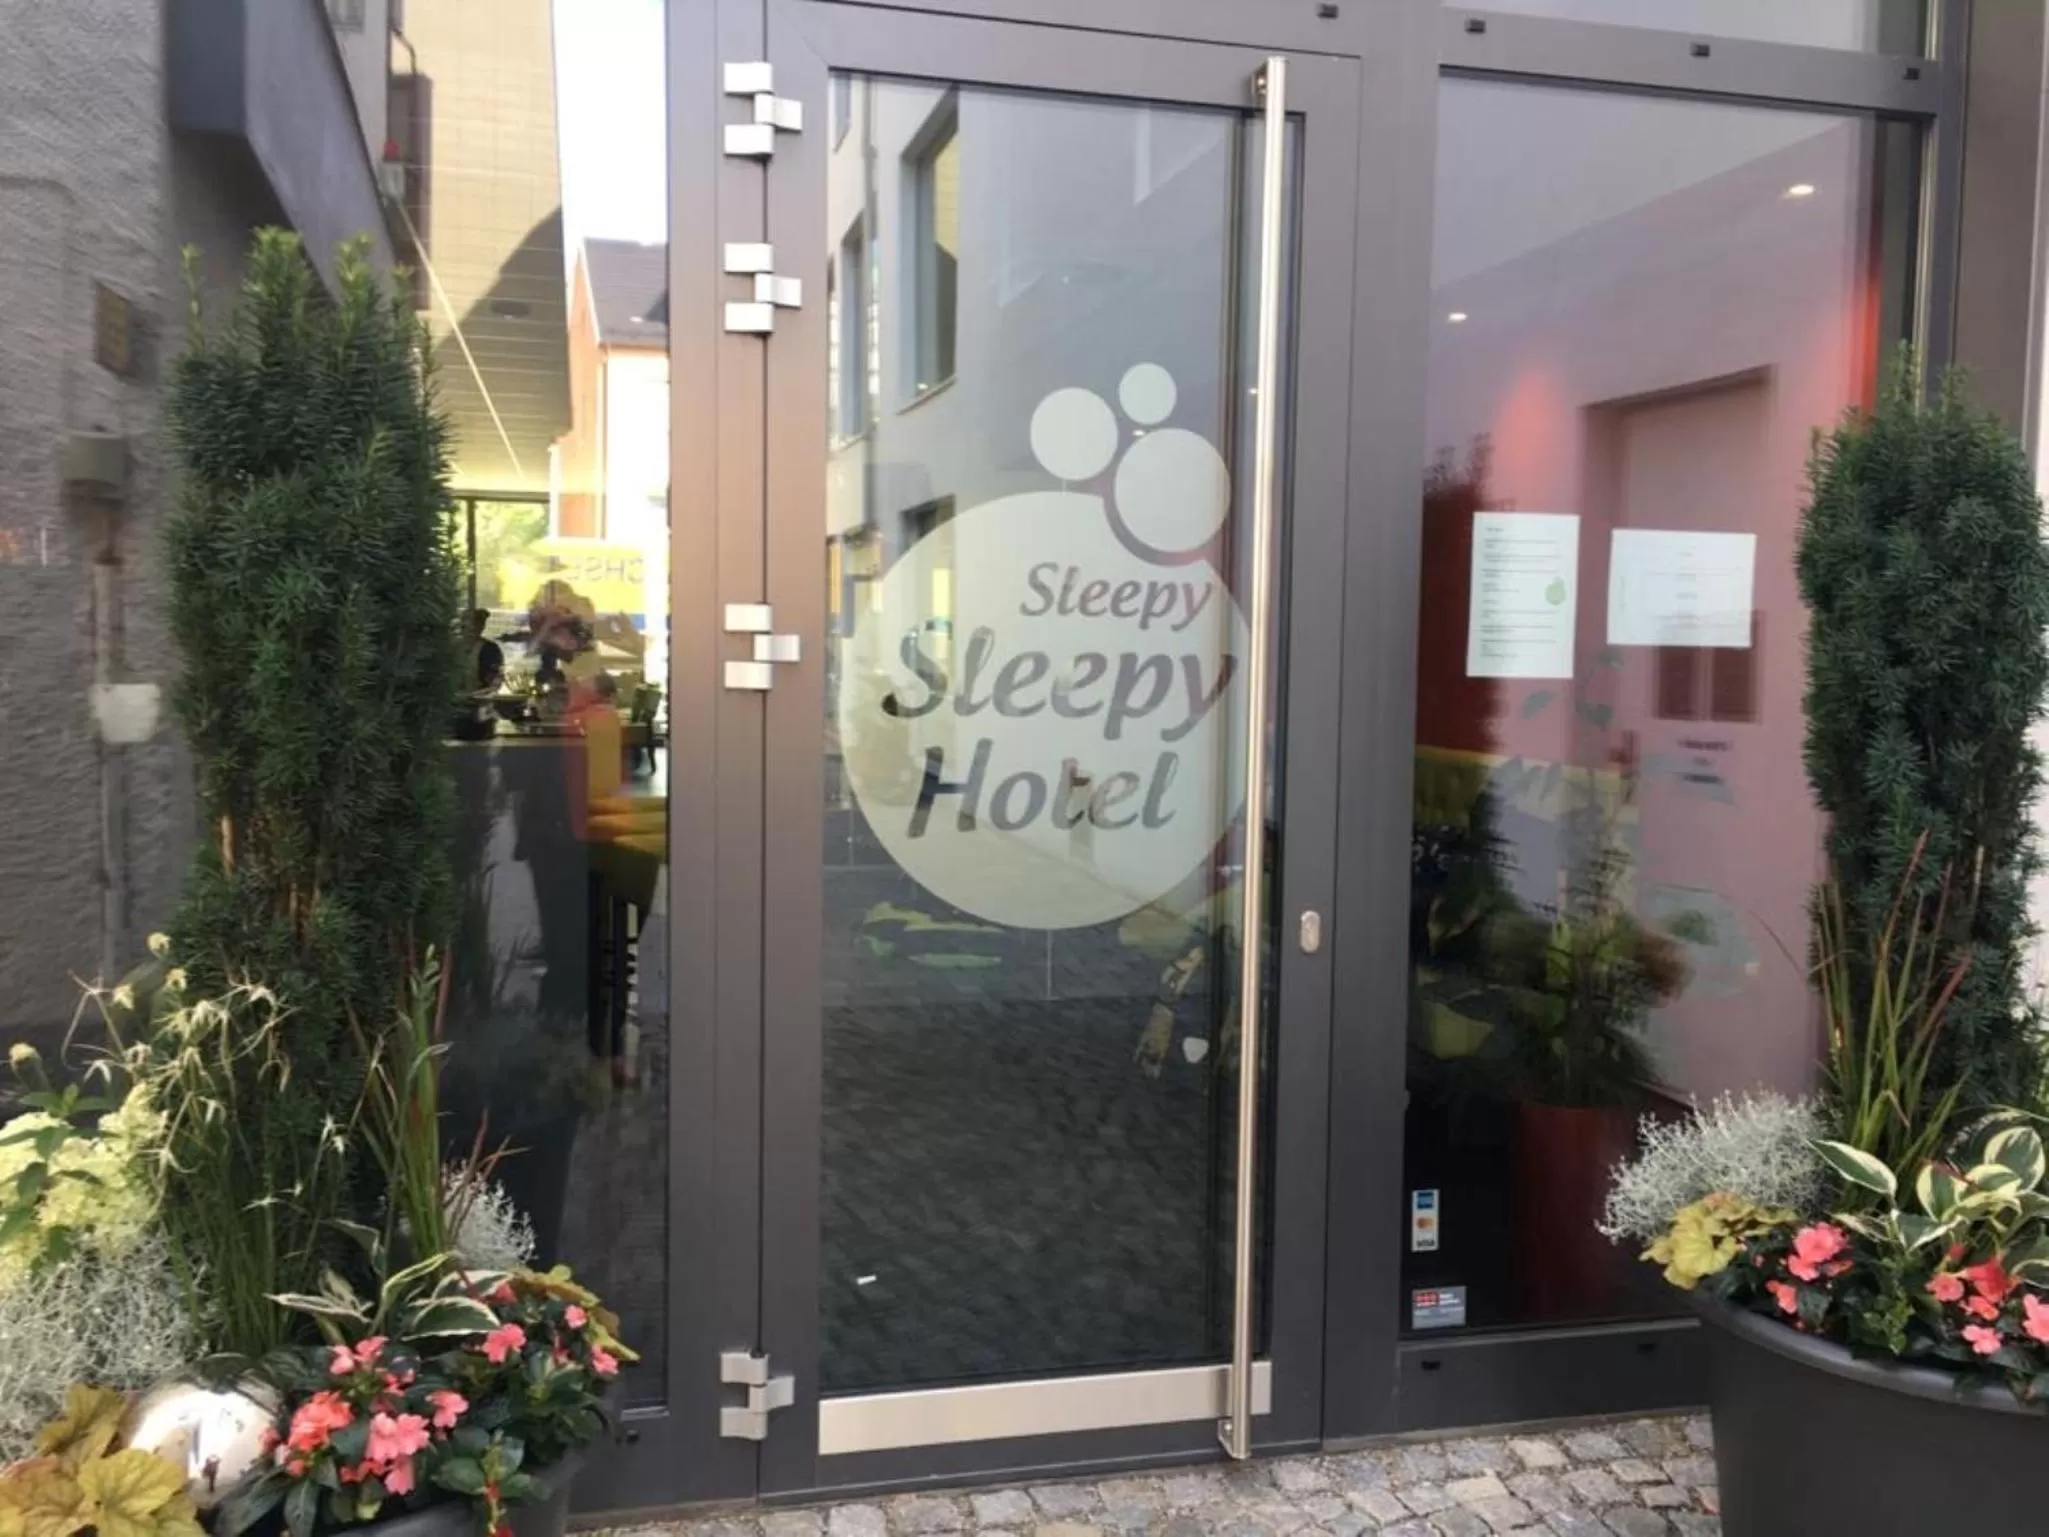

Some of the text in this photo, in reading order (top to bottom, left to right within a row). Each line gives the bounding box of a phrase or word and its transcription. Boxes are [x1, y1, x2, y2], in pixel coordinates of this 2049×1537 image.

[1019, 562, 1213, 632] Sleepy
[881, 619, 1238, 742] Sleepy
[907, 737, 1180, 839] Hotel
